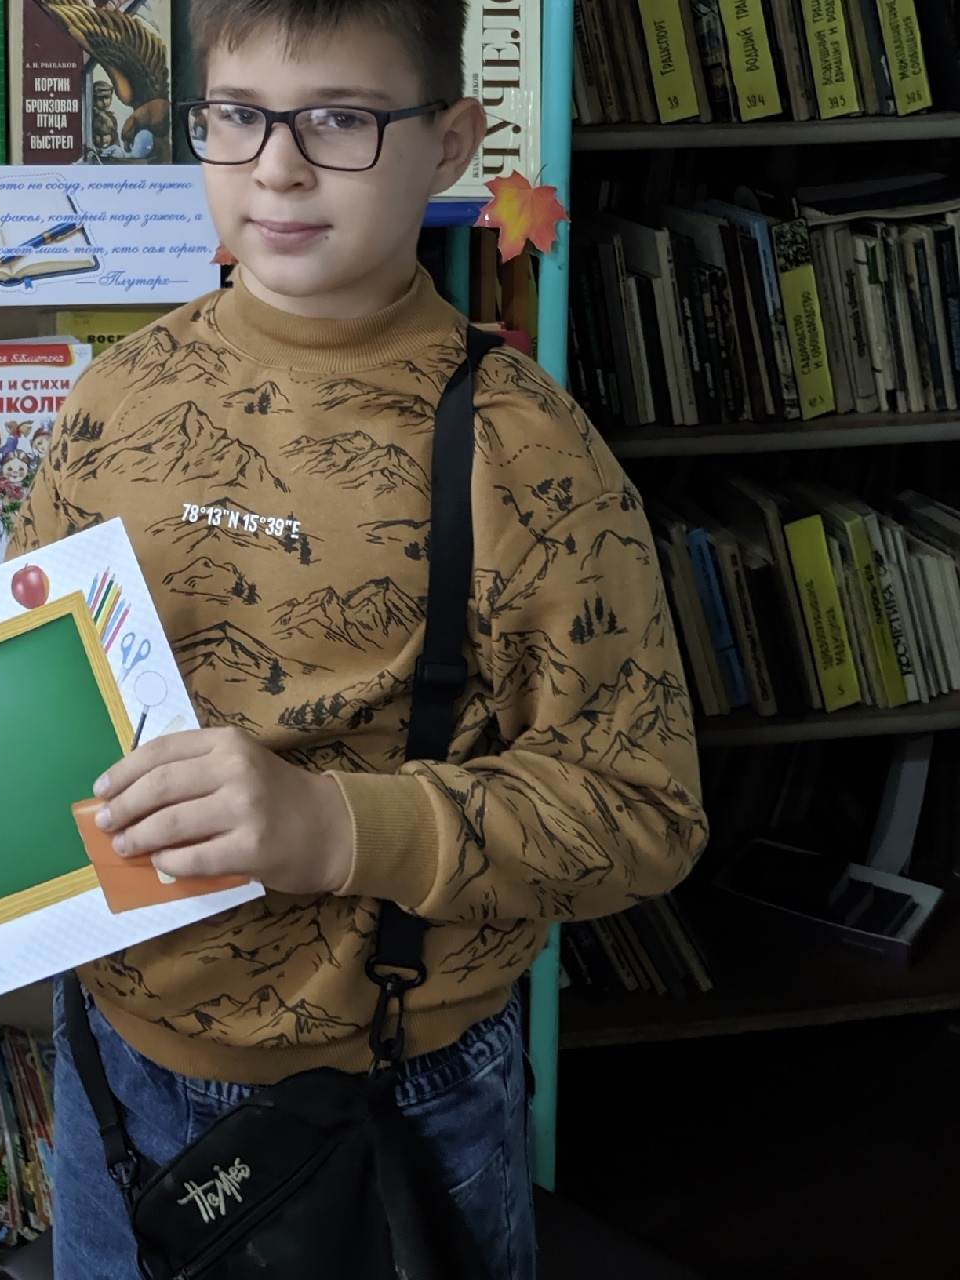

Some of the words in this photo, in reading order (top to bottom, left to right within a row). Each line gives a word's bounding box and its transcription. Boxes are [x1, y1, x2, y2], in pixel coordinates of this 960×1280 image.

[736, 26, 760, 72] ВОДНЫЙ
[34, 78, 71, 92] КОРТИК
[25, 99, 79, 113] БРОНЗОВАЯ
[36, 114, 67, 130] ПТИЦА
[30, 135, 74, 149] ВЫСТРЕЛ
[45, 182, 84, 195] сосуд,
[87, 180, 146, 194] который
[149, 182, 192, 194] нужно
[0, 213, 45, 227] факел,
[48, 212, 106, 225] который
[110, 214, 140, 227] надо
[140, 214, 191, 227] зажечь,
[194, 213, 203, 221] а
[74, 246, 108, 256] тот,
[111, 245, 138, 254] кто
[169, 243, 212, 258] горит.
[793, 314, 811, 375] САДОВОДСТВО
[8, 380, 17, 390] И
[21, 379, 70, 390] СТИХИ
[884, 584, 912, 676] КОСМЕТИКА
